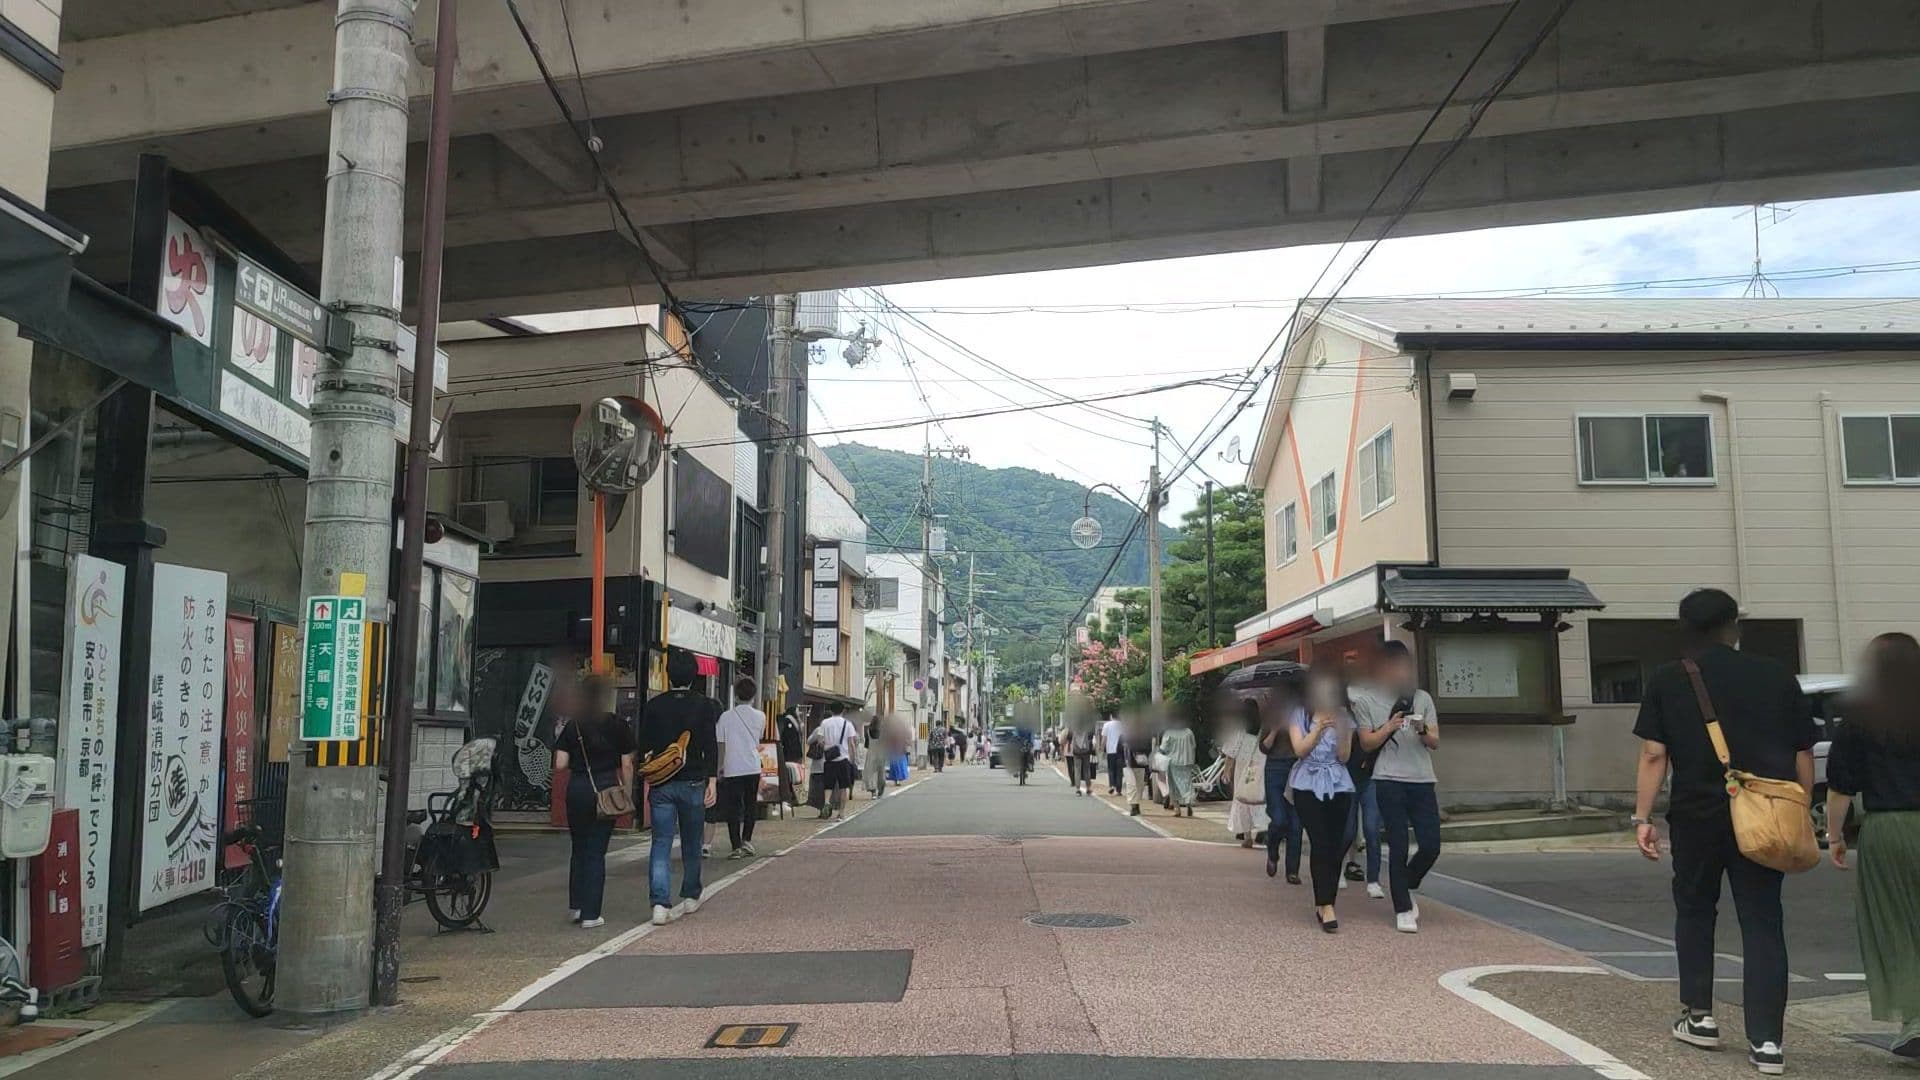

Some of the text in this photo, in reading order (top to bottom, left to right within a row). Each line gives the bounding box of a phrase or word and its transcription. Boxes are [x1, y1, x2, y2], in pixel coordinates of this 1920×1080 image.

[178, 596, 196, 755] 防火のきめて
[199, 599, 216, 795] あなたの注意が
[151, 857, 207, 893] 火事は119
